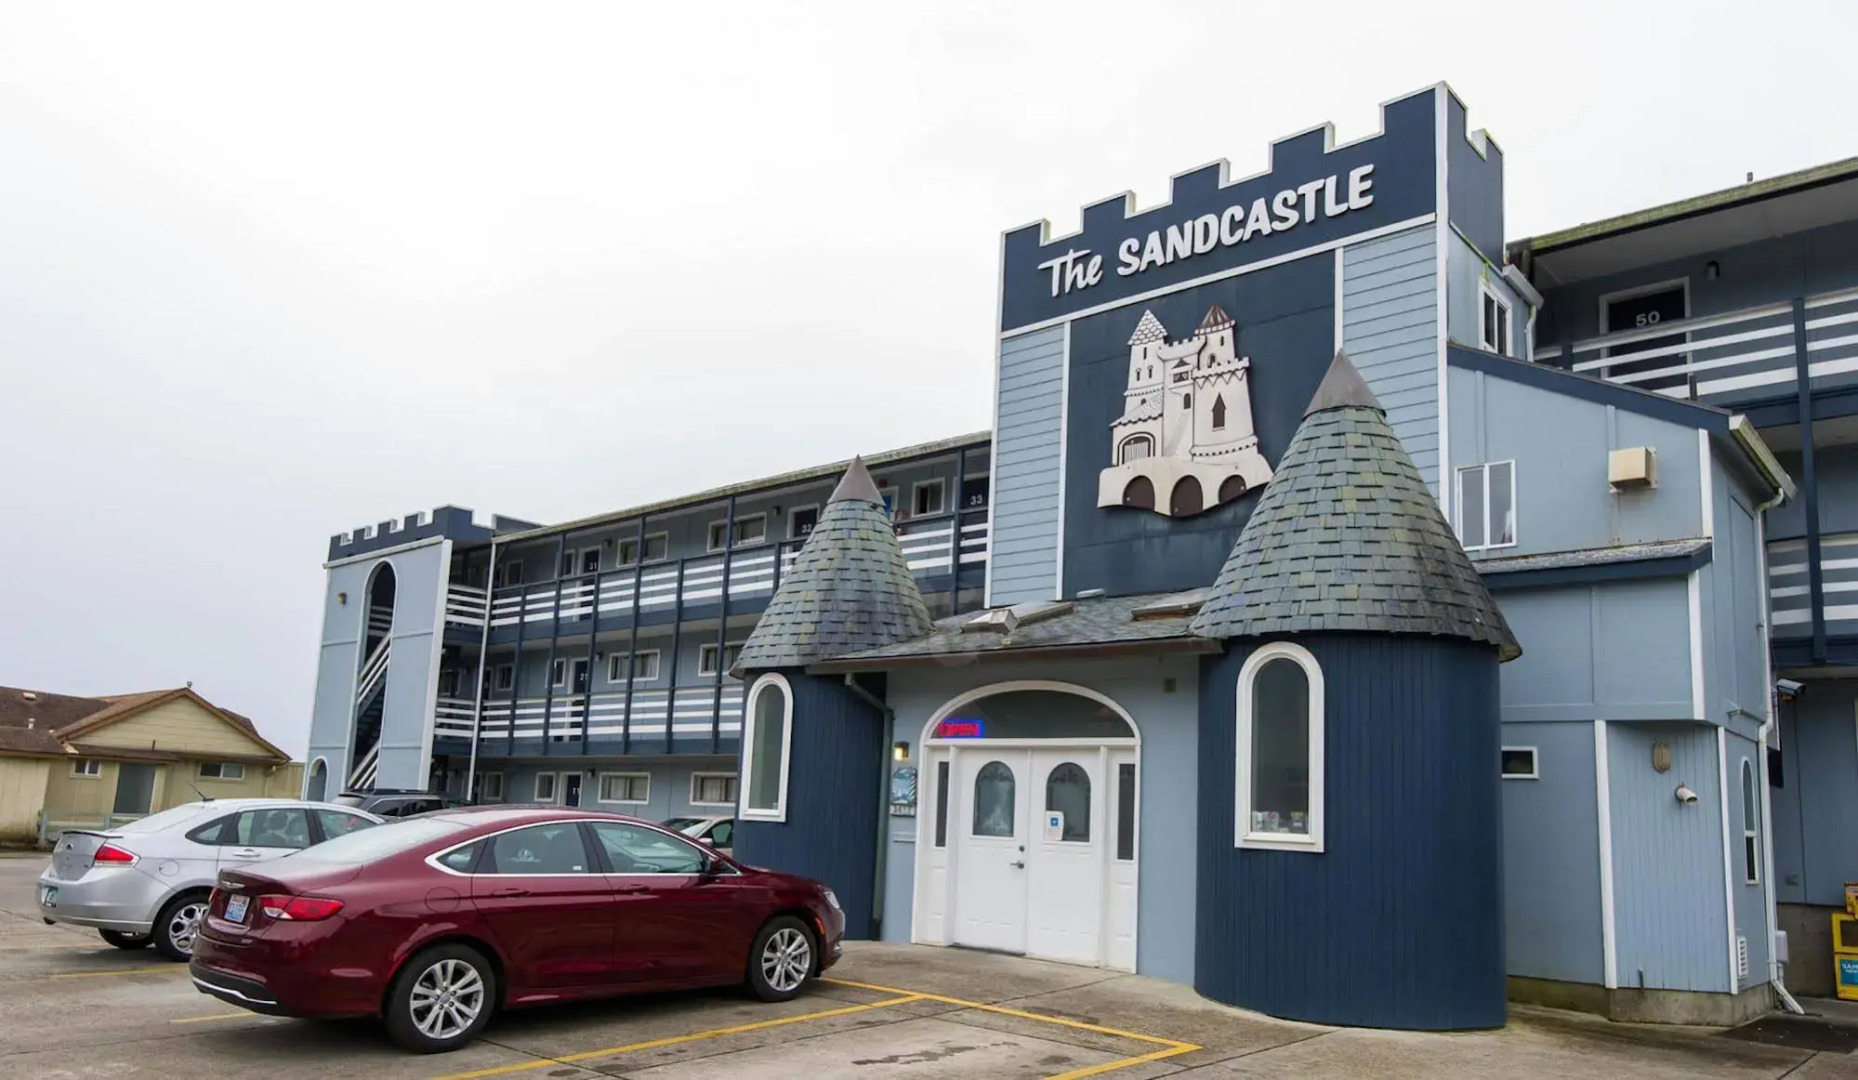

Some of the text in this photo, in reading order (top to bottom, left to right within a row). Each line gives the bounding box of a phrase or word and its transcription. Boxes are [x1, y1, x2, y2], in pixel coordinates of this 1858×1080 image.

[1038, 164, 1375, 297] The SANDCASTLE
[1636, 311, 1660, 327] 50
[970, 494, 983, 506] 33
